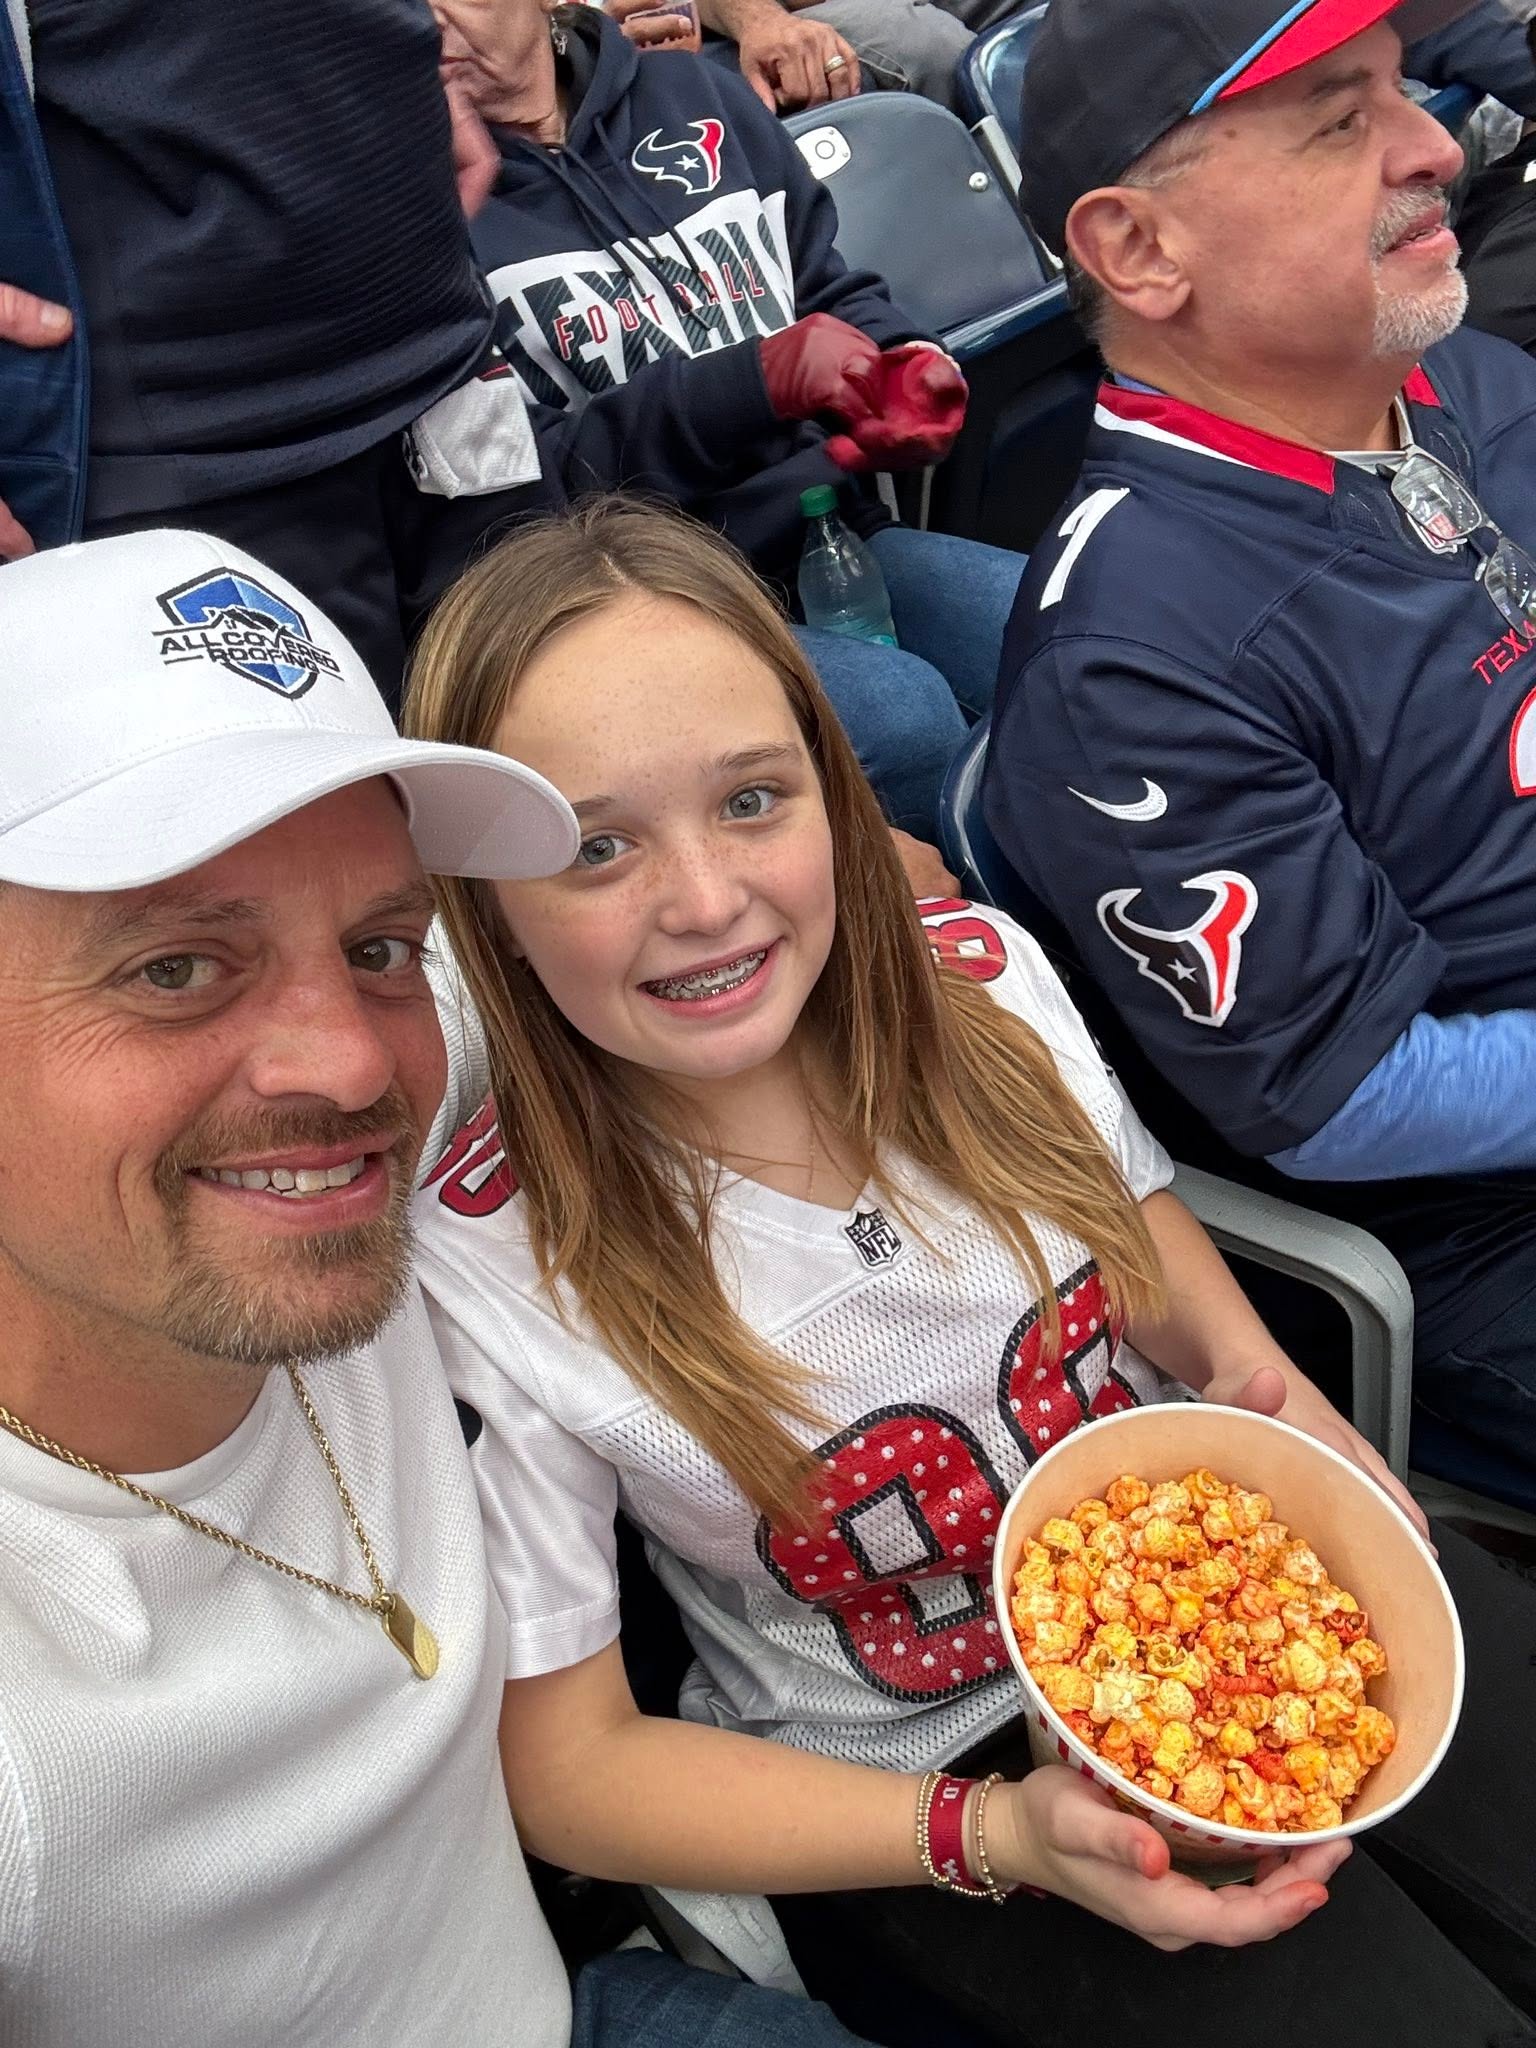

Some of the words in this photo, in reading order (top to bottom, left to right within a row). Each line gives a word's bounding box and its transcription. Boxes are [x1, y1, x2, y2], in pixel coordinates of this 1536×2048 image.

[552, 259, 765, 360] FOOTBALL
[207, 648, 321, 674] ROOFING
[858, 1227, 900, 1262] NFL
